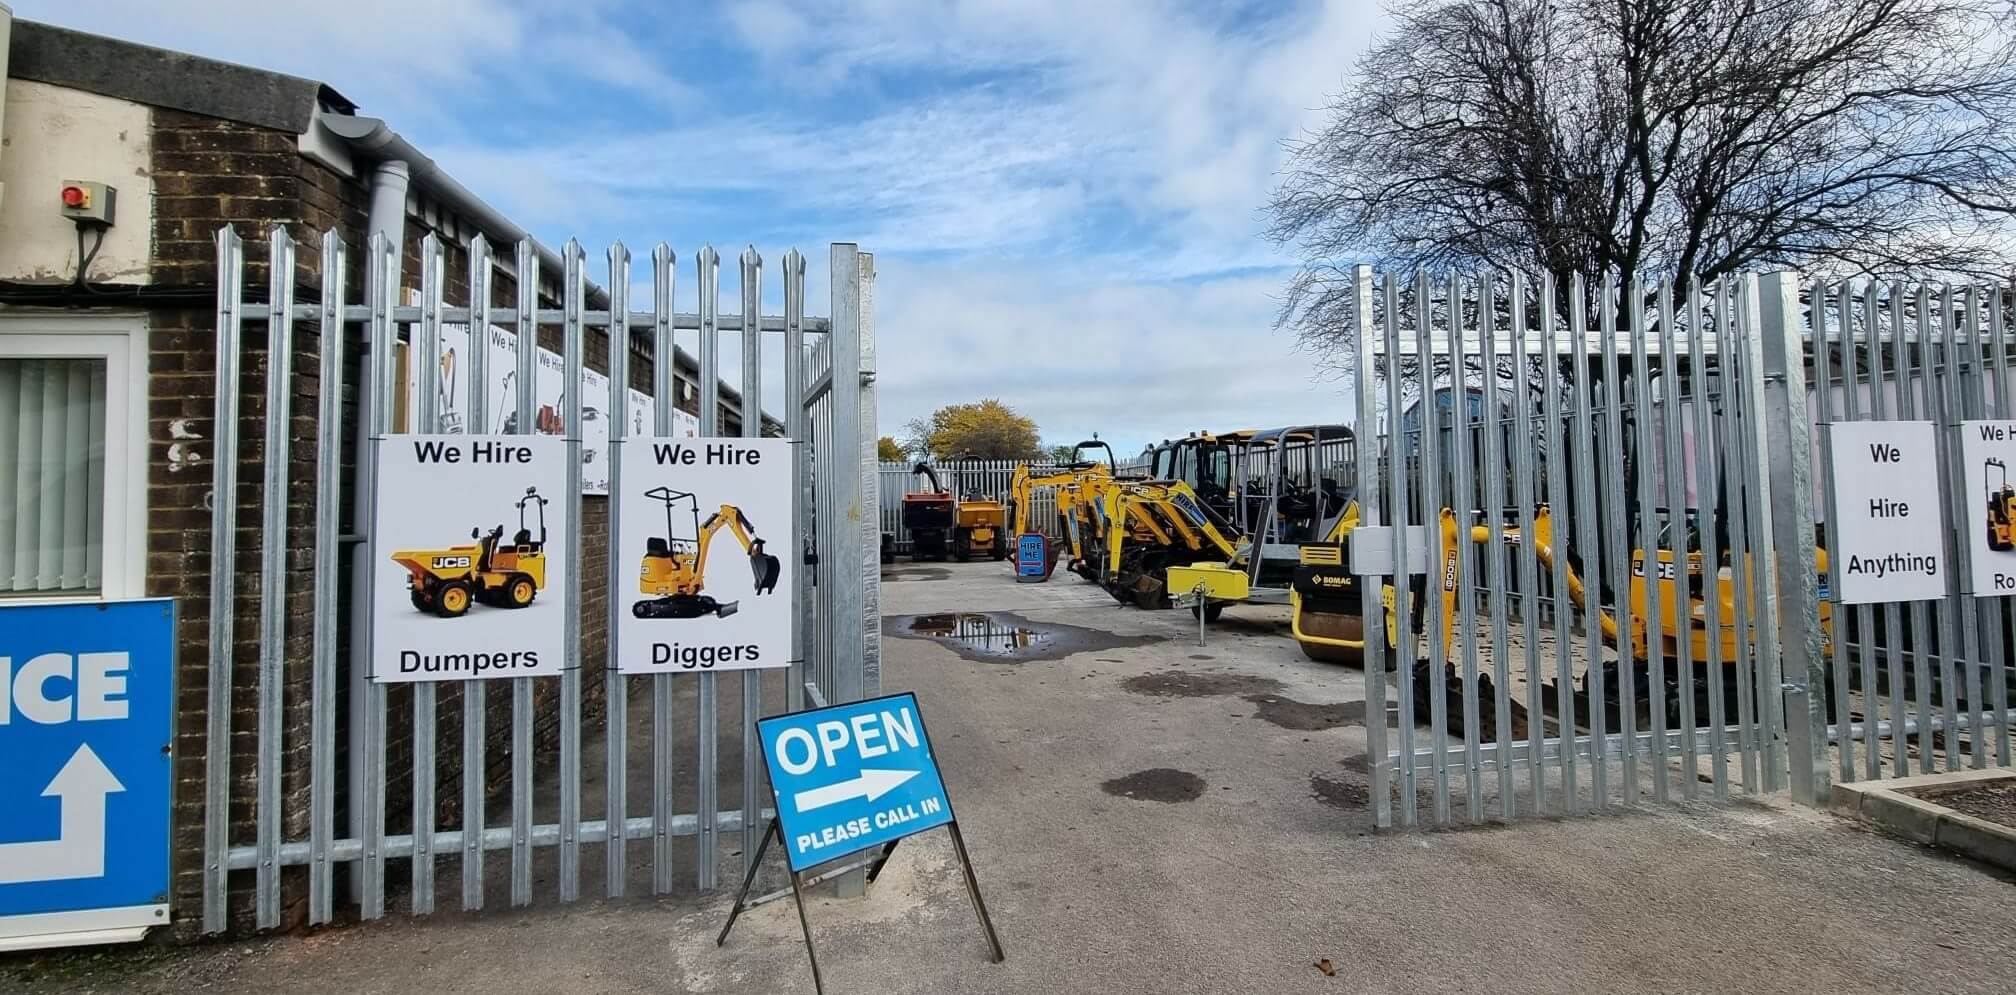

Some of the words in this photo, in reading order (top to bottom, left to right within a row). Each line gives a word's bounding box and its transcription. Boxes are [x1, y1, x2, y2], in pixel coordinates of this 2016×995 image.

[491, 329, 506, 349] We
[1979, 425, 2004, 441] We
[414, 441, 461, 463] We
[472, 441, 532, 464] Hire
[653, 443, 696, 465] We
[706, 443, 761, 465] Hire
[1870, 443, 1901, 463] We
[1869, 498, 1909, 518] Hire
[1020, 542, 1041, 550] HIRE
[1024, 551, 1039, 559] ME
[432, 557, 470, 569] JCB
[1848, 552, 1936, 578] Anything
[1323, 576, 1352, 585] BOMAG
[400, 650, 539, 675] Dumpers
[652, 643, 760, 669] Diggers
[775, 707, 920, 775] OPEN
[796, 817, 872, 854] PLEASE
[874, 804, 920, 829] CALL
[920, 797, 941, 815] IN
